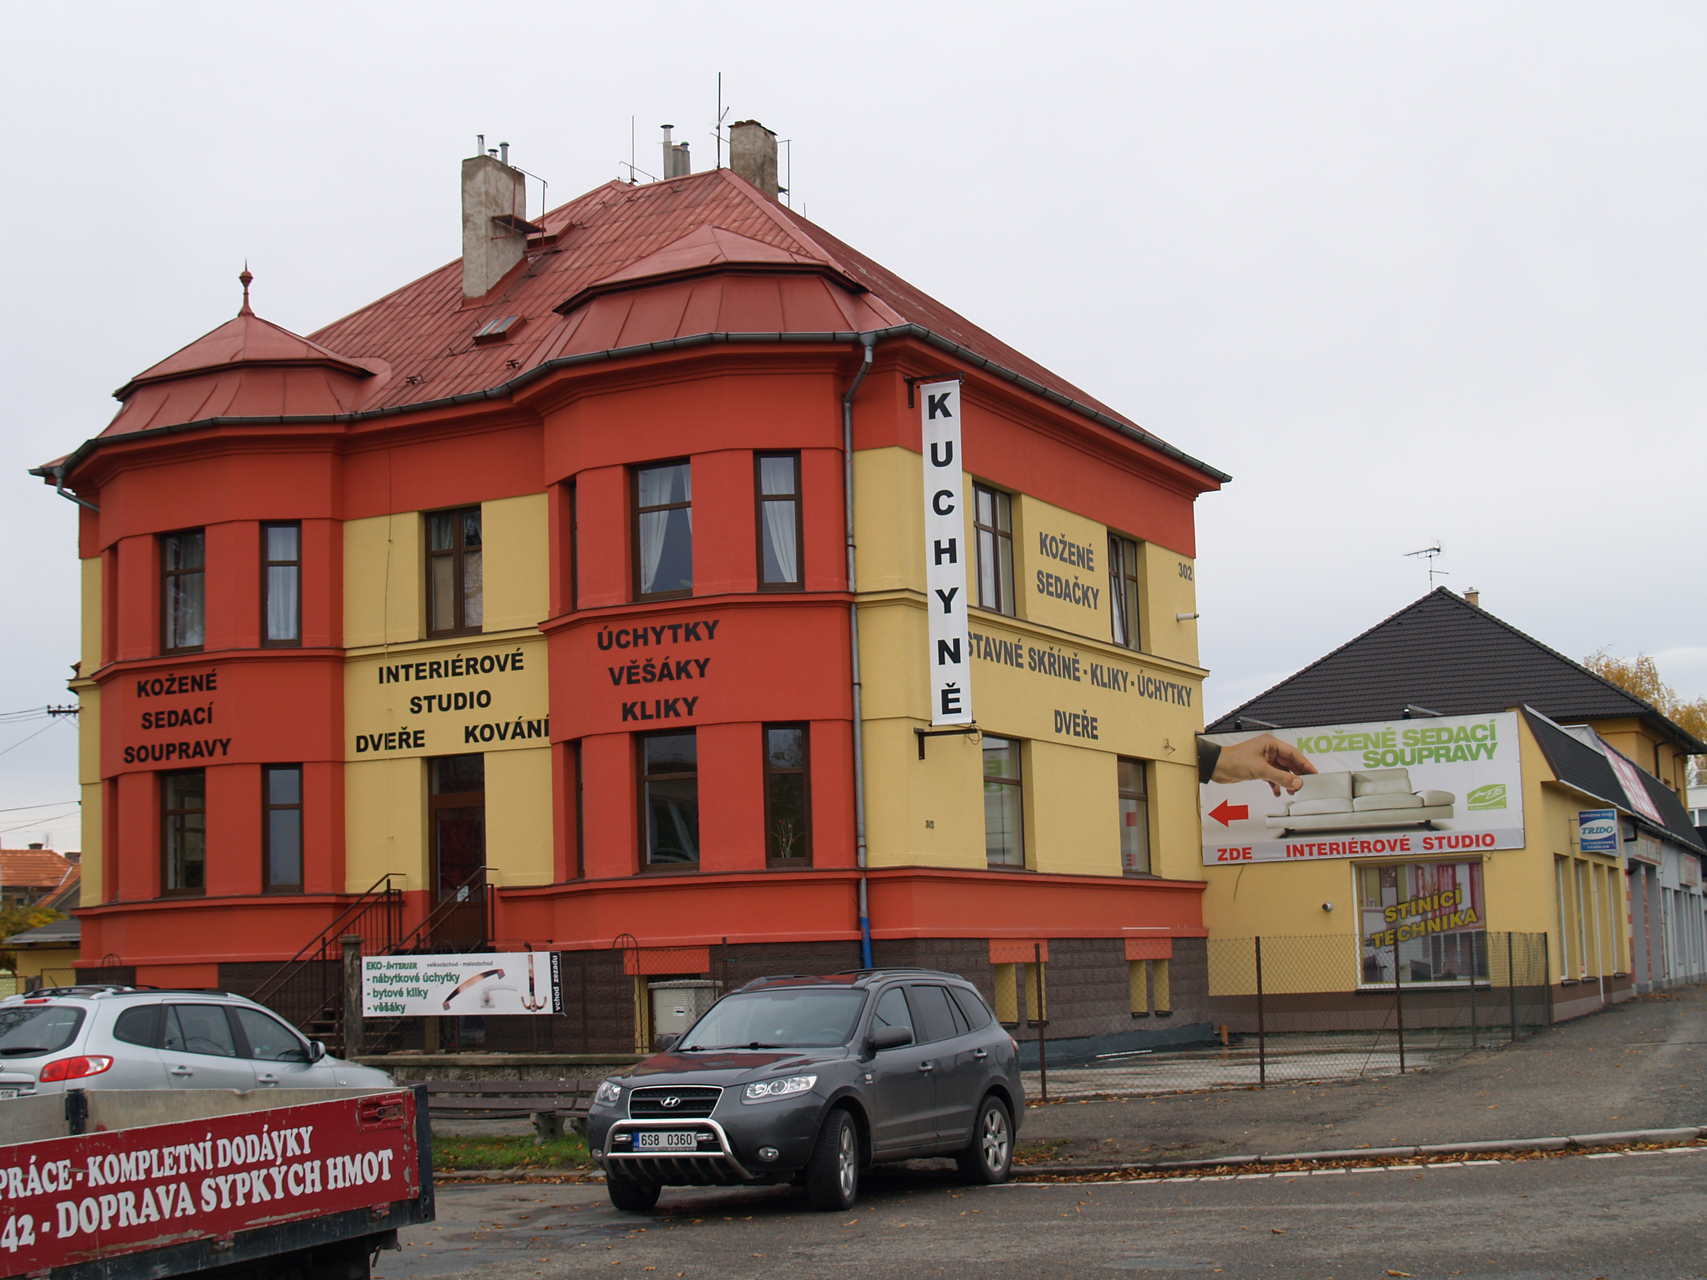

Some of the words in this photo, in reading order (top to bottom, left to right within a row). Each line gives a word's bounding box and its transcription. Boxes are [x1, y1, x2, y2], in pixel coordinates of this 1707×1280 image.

[926, 392, 962, 715] KUCHYNĚ
[1039, 531, 1095, 572] KOŽENÉ
[1178, 562, 1193, 581] 302
[1036, 569, 1100, 610] SEDAČKY
[597, 619, 720, 651] ÚCHYTKY
[378, 648, 524, 684] INTERIÉROVÉ
[608, 657, 711, 686] VĚŠÁKY
[1028, 645, 1081, 682] SKŘÍNĚ
[1090, 662, 1129, 693] KLIKY
[1137, 669, 1192, 708] ÚCHYTKY
[136, 669, 218, 698] KOŽENÉ
[141, 702, 214, 729] SEDACÍ
[409, 689, 492, 714] STUDIO
[622, 696, 699, 722] KLIKY
[355, 727, 425, 753] DVEŘE
[464, 713, 549, 744] KOVÁNÍ
[1054, 709, 1099, 740] DVEŘE
[1297, 726, 1396, 755] KOŽENÉ
[1402, 719, 1497, 749] SEDACÍ
[124, 738, 232, 764] SOUPRAVY
[1363, 742, 1498, 769] SOUPRAVY
[1581, 826, 1613, 834] TRIDO
[1217, 847, 1253, 862] ZDE
[1286, 834, 1411, 858] INTERIÉROVÉ
[1422, 833, 1496, 852] STUDIO
[1384, 883, 1462, 923] STÍNÍCÍ
[1371, 908, 1478, 949] TECHNIKA
[372, 972, 420, 986] nábytkové
[422, 972, 460, 985] úchytky
[551, 955, 559, 983] zezadu
[372, 987, 404, 1000] bytové
[406, 987, 429, 1000] kliky
[373, 1001, 406, 1014] věšáky
[552, 986, 561, 1012] vchod
[641, 1134, 660, 1146] 6S8
[667, 1133, 692, 1146] 0360
[87, 1132, 213, 1187] KOMPLETNÍ
[217, 1124, 314, 1168] DODÁVKY
[56, 1181, 197, 1239] DOPRAVA
[200, 1155, 321, 1213] SYPKÝCH
[326, 1148, 394, 1190] HMOT
